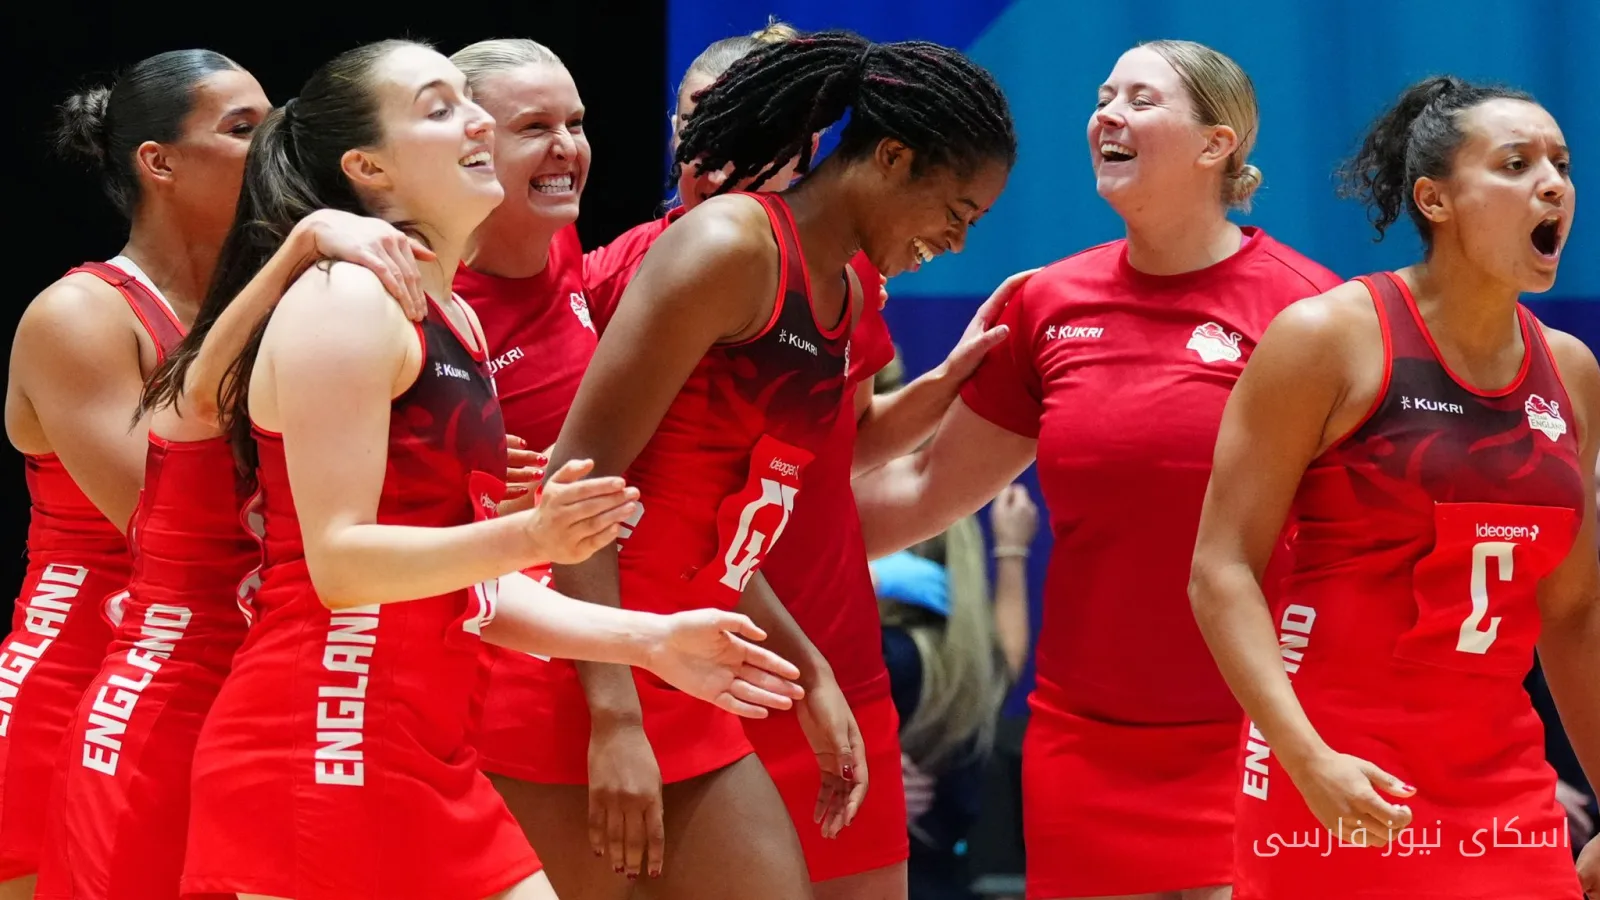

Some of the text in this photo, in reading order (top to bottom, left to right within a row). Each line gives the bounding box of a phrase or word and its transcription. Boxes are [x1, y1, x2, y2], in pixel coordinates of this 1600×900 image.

[1058, 325, 1104, 340] KUKRI
[789, 332, 818, 356] KUKRI
[486, 346, 525, 374] UKRI
[443, 363, 471, 381] KUKRI
[1414, 397, 1464, 415] KUKRI
[1531, 418, 1565, 432] ENGLAND
[1476, 523, 1528, 540] Ideagen
[1456, 541, 1521, 655] C
[0, 563, 89, 737] NGLAND
[82, 603, 193, 777] ENGLAND
